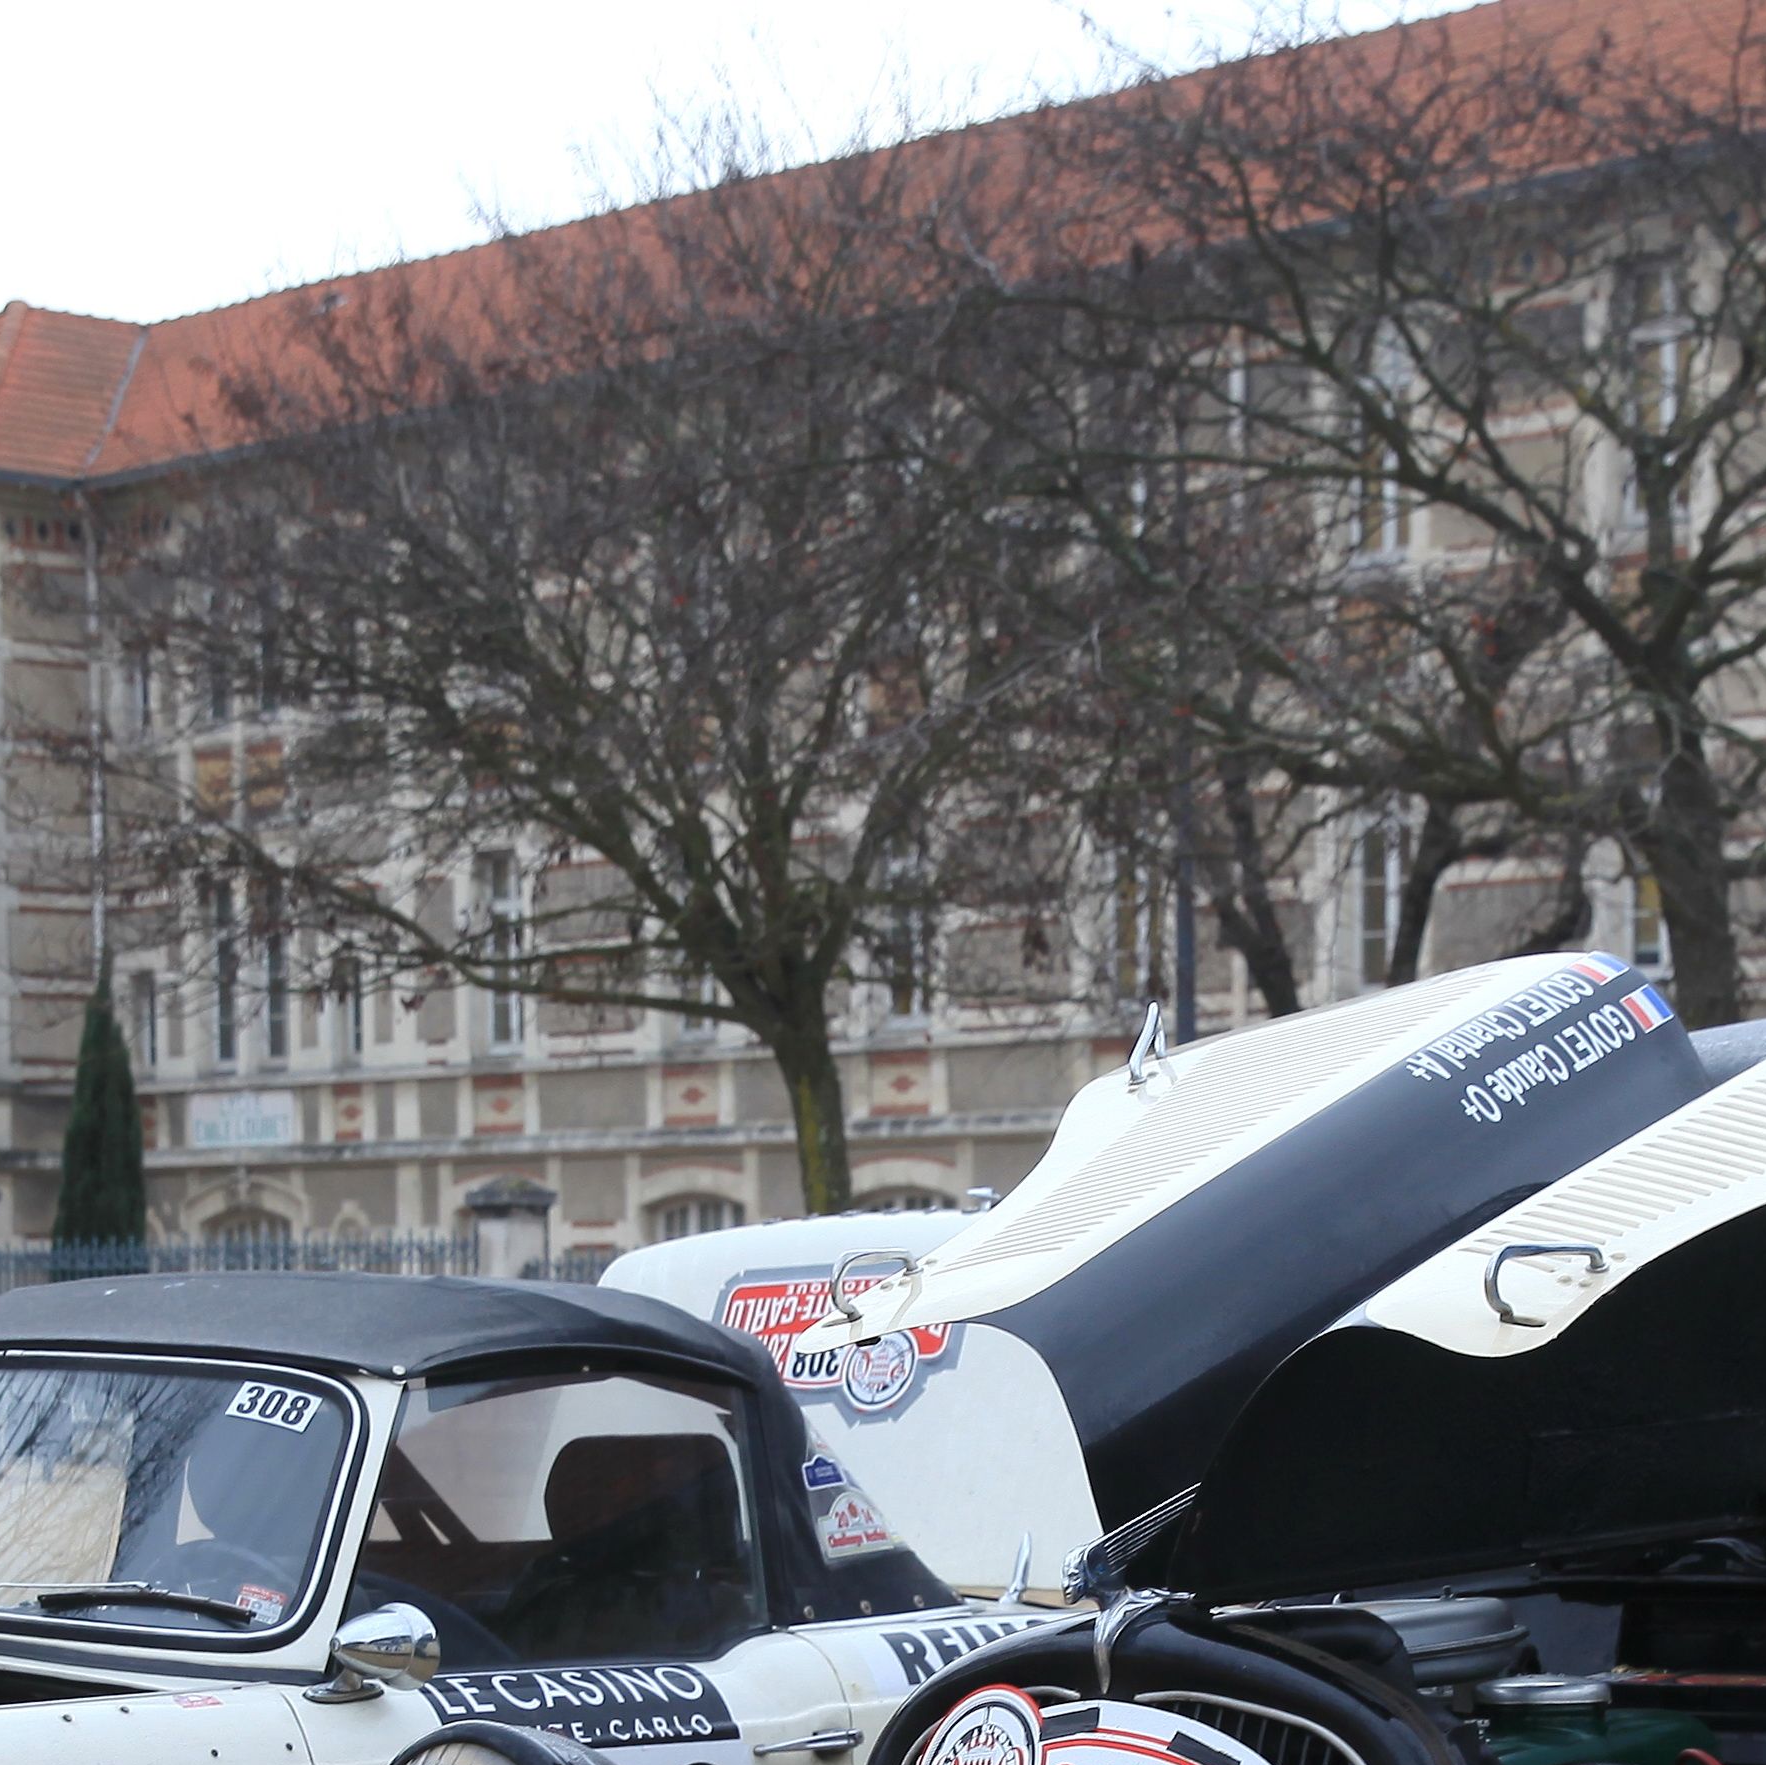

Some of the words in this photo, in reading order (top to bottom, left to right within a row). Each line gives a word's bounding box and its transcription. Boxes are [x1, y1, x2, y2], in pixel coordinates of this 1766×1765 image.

[1513, 972, 1594, 1028] GOYET
[1433, 1004, 1528, 1072] Chantal
[1554, 1003, 1637, 1073] GOYET
[1485, 1043, 1571, 1106] Claude
[1460, 1084, 1503, 1123] O+
[236, 1385, 312, 1426] 308
[425, 1677, 498, 1715] LE
[491, 1665, 704, 1711] CASINO
